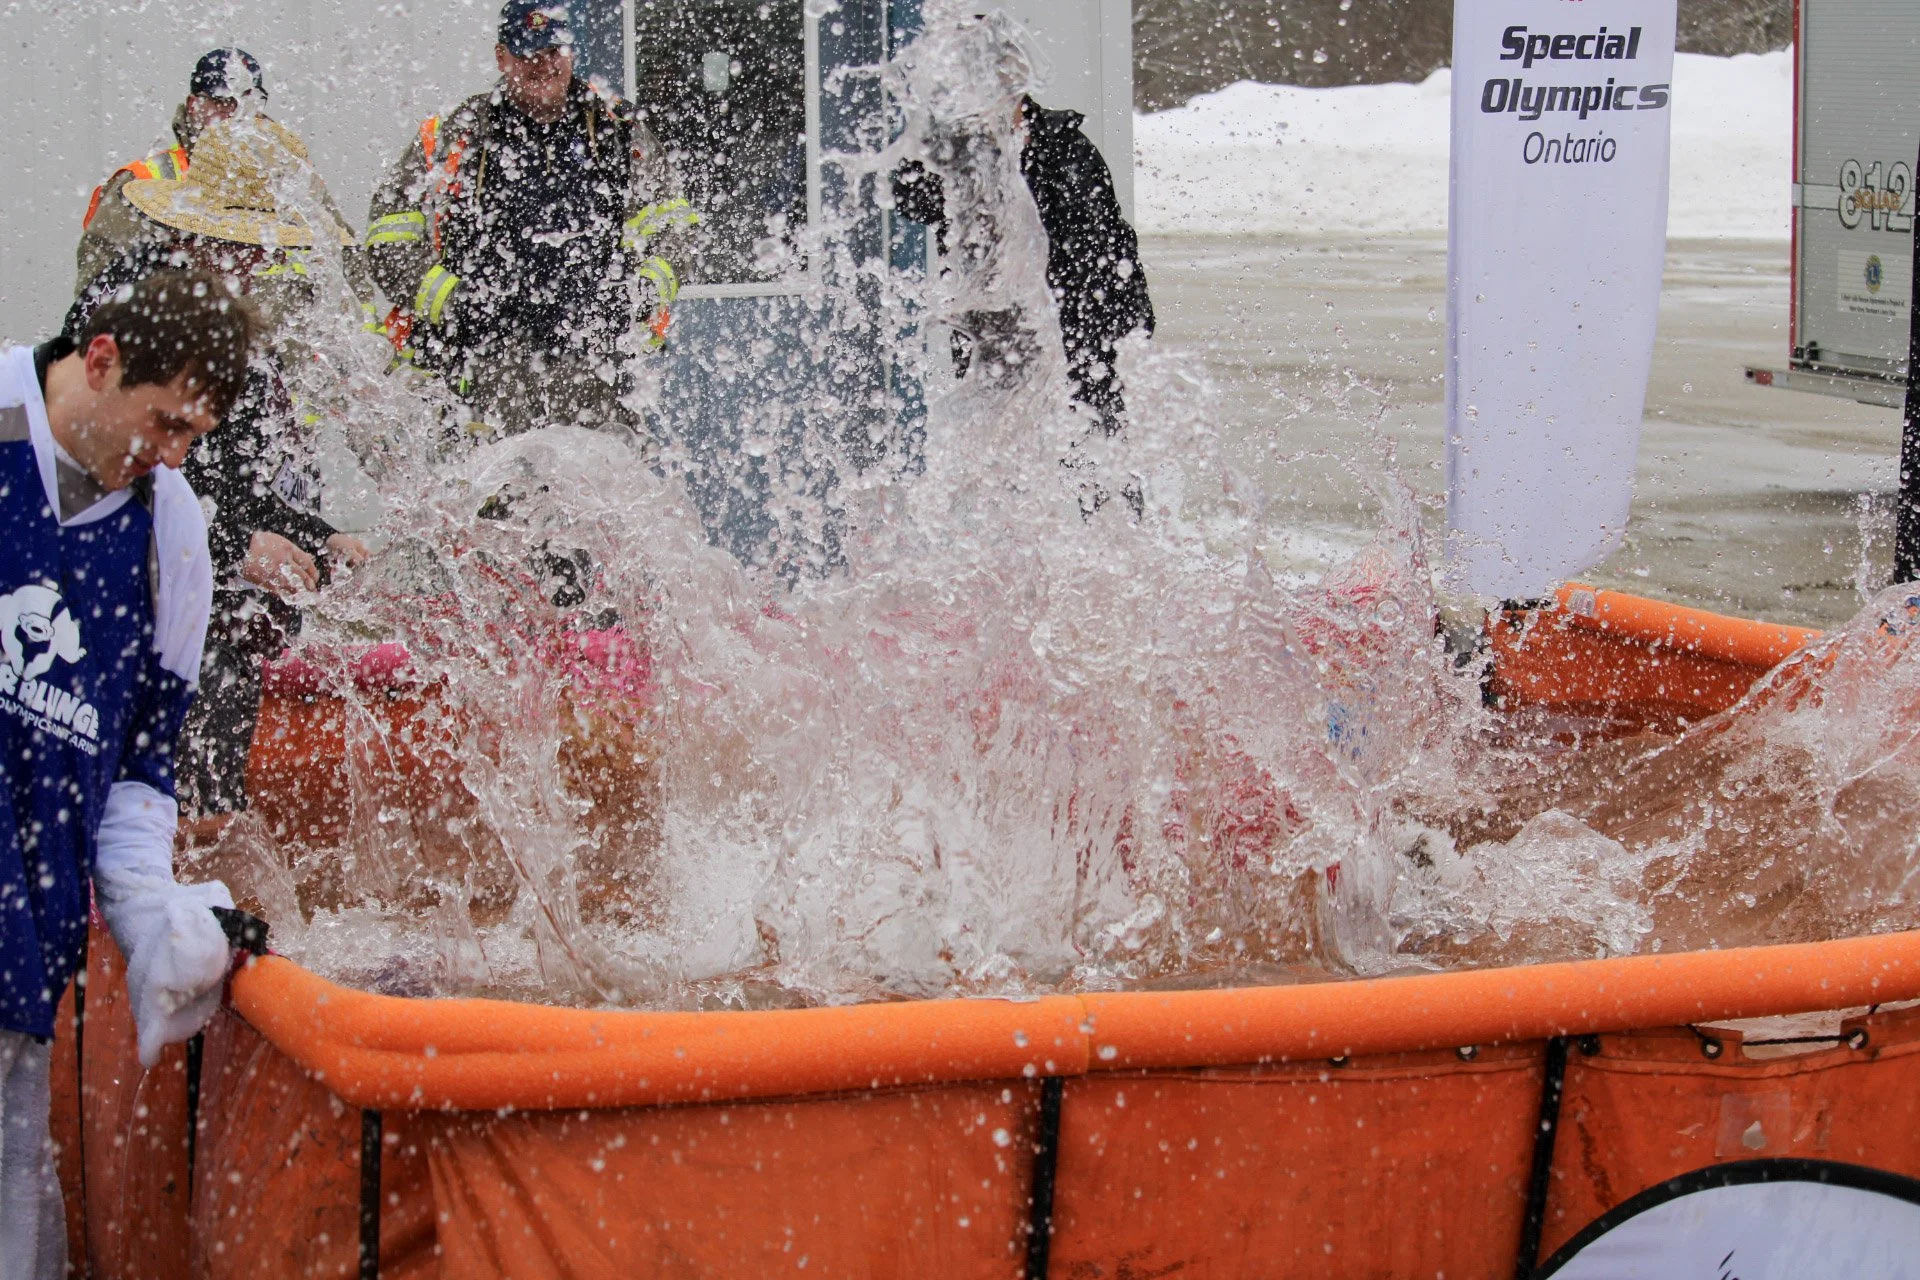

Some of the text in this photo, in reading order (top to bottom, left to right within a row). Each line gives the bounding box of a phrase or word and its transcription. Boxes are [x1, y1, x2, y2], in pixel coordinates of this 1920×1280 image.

[1500, 26, 1642, 68] Special
[1481, 77, 1669, 121] Olympics
[1523, 130, 1616, 164] Ontario
[1838, 159, 1912, 233] 812
